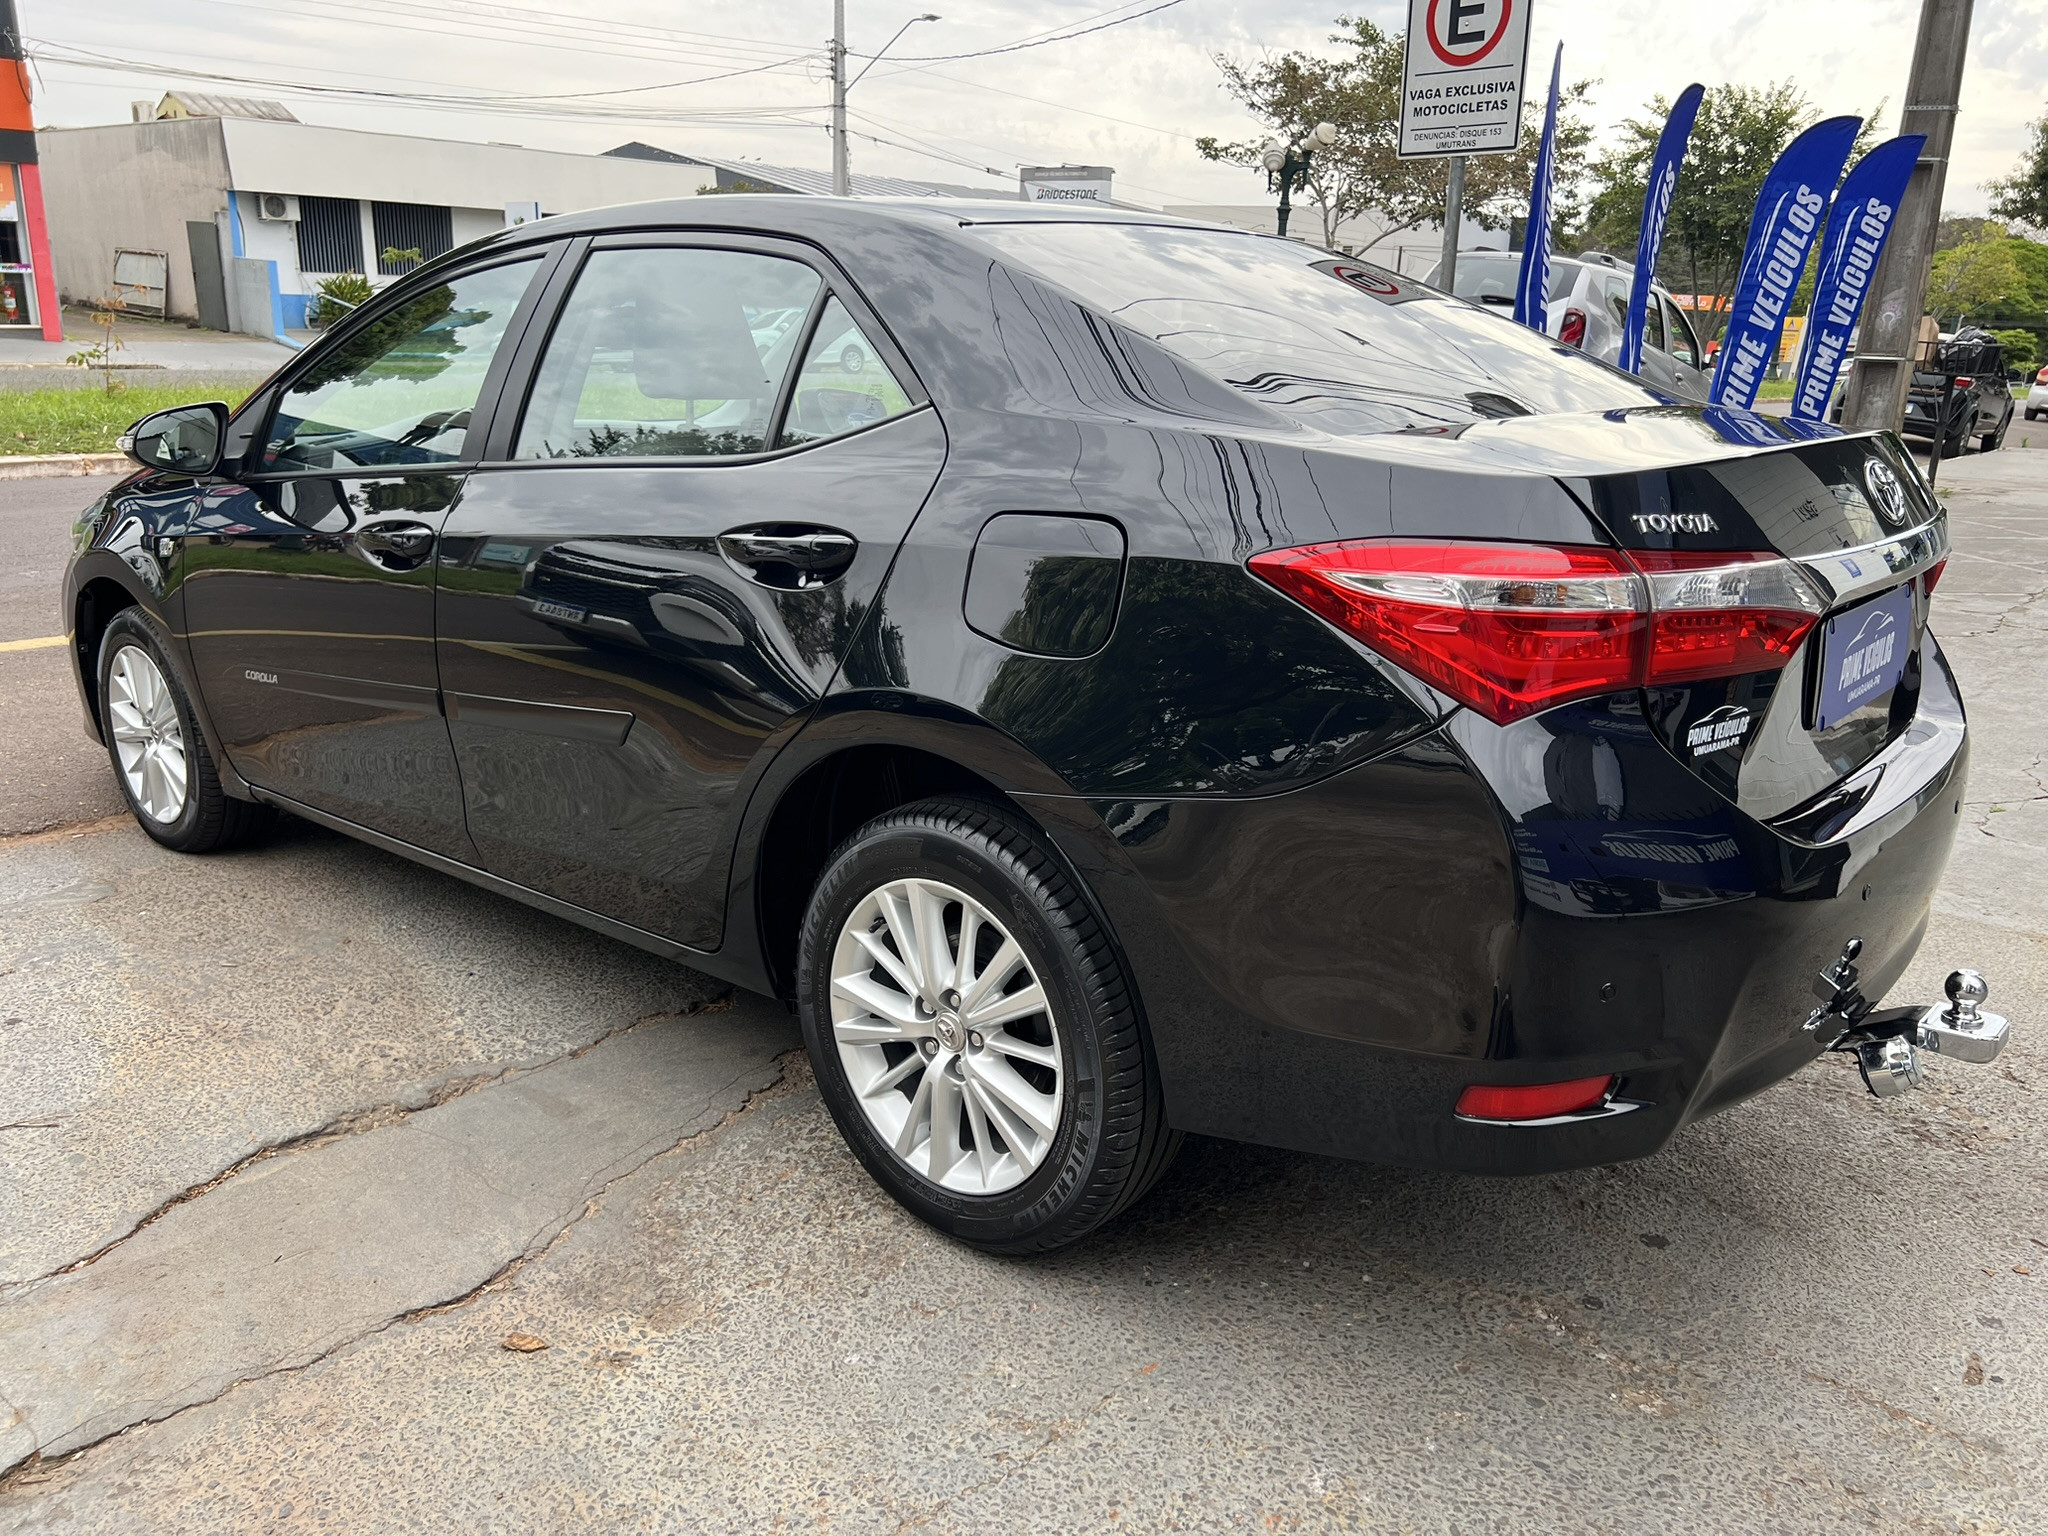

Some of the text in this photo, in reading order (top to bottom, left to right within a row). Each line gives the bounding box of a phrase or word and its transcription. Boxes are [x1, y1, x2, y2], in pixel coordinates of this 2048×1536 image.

[1447, 0, 1486, 46] E
[1409, 80, 1516, 101] VAGA EXCLUSIVA
[1413, 99, 1509, 118] MOTOCICLETAS
[1459, 129, 1488, 138] DISQUE
[1489, 127, 1502, 136] 153
[1435, 139, 1477, 150] UMUTRANS
[1036, 188, 1098, 200] BRIDGESTONE
[1721, 183, 1824, 411] RIME VEÍCULOS
[1800, 197, 1892, 418] PRIME VEÍCULOS
[1631, 513, 1720, 534] TOYOTA
[245, 669, 279, 684] COROLLA
[1839, 647, 1866, 692] PRIME
[1686, 724, 1715, 748] PRIME
